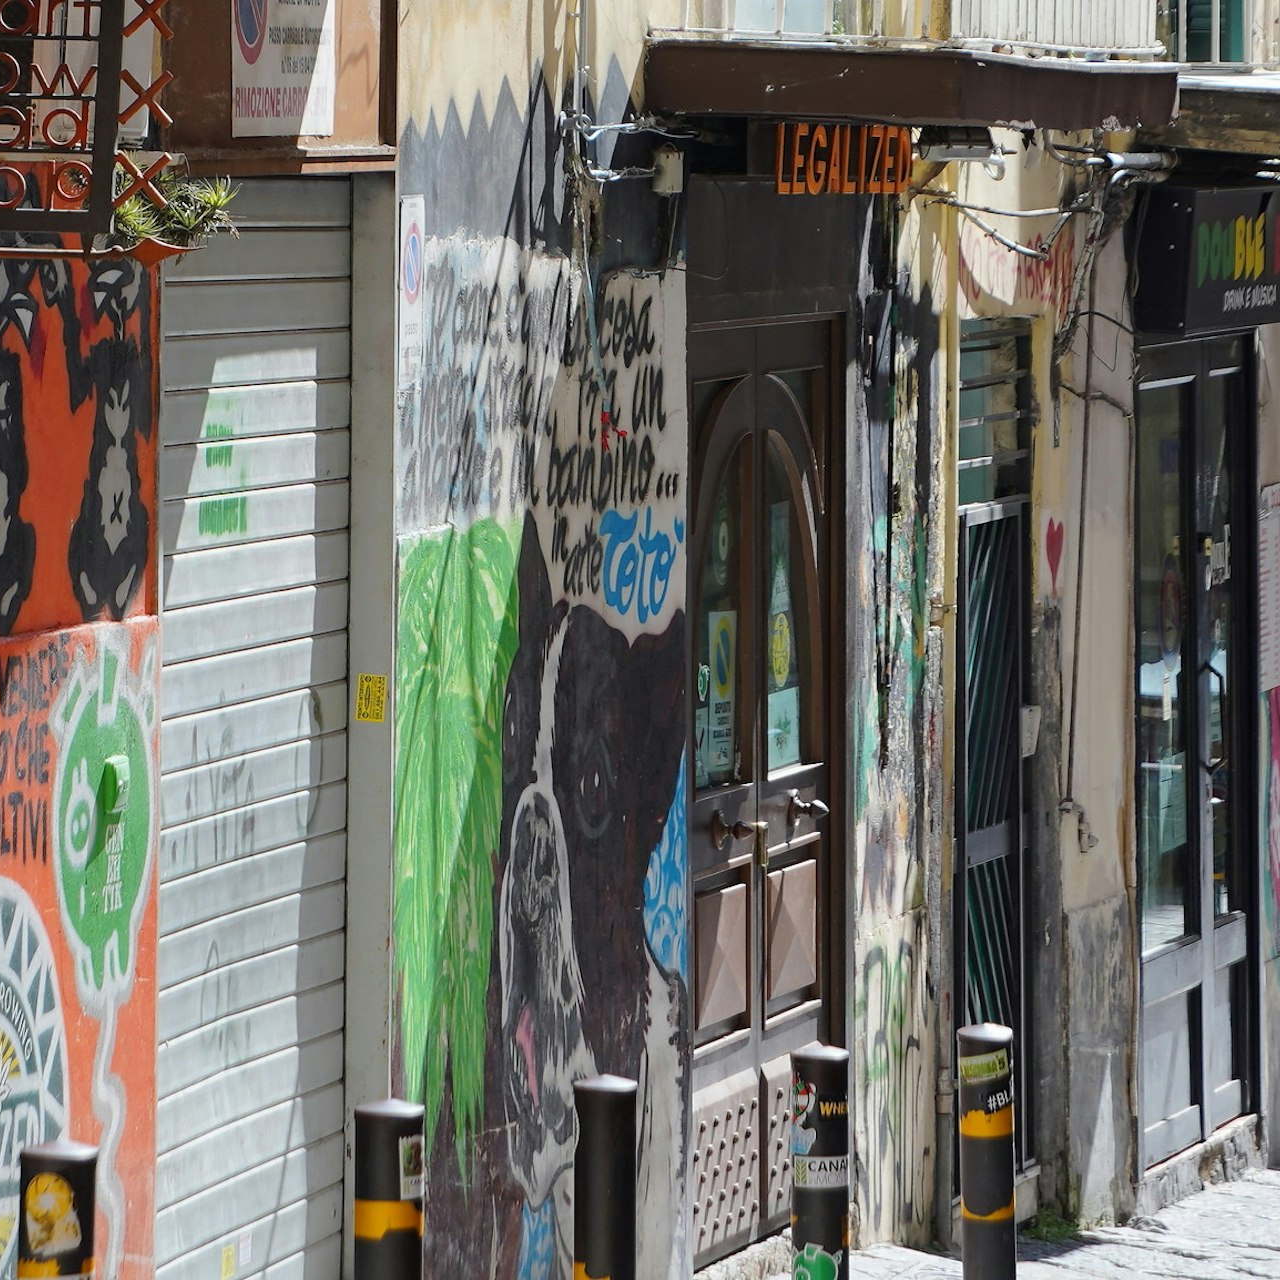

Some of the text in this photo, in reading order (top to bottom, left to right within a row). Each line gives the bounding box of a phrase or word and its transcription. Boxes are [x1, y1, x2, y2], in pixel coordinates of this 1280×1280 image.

[235, 86, 281, 118] RIMOZIONE
[776, 121, 913, 196] LEGALIZED
[1196, 211, 1267, 290] DOUBLE
[1223, 283, 1278, 313] DRINK E MUSICA
[631, 364, 668, 435] un
